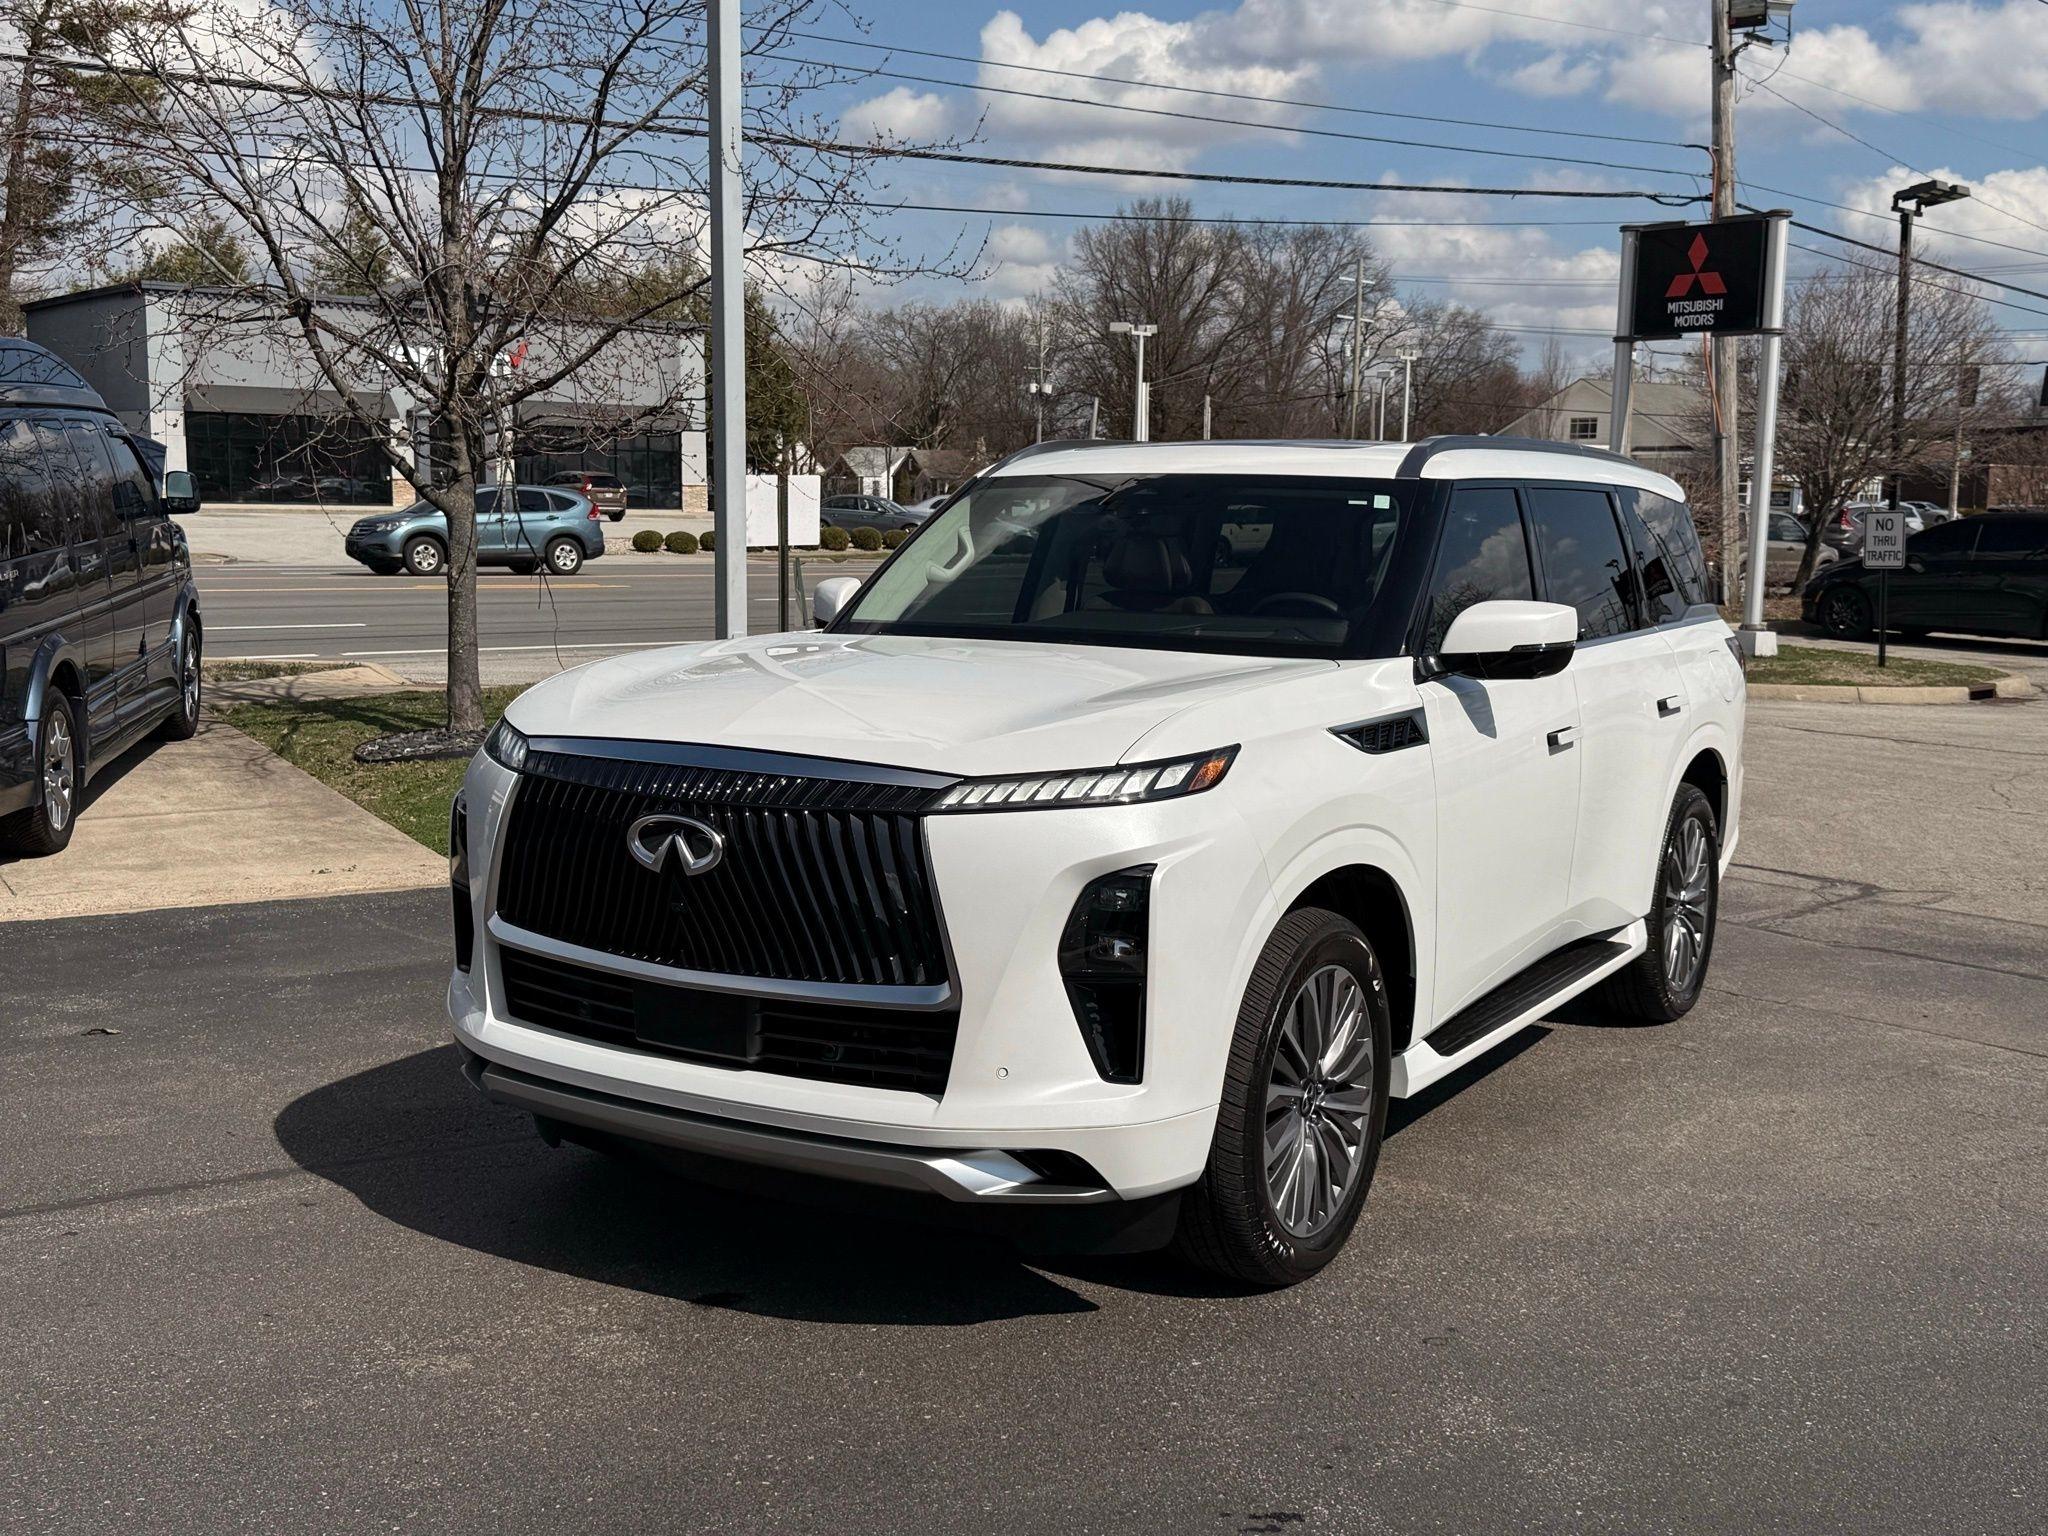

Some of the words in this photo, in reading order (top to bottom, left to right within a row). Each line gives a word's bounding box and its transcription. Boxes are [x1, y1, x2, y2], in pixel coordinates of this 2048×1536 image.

[1667, 298, 1724, 314] MITSUBISHI
[1674, 314, 1714, 327] MOTORS
[1875, 518, 1894, 531] NO
[1873, 536, 1897, 547] THRU
[1867, 551, 1902, 561] TRAFFIC
